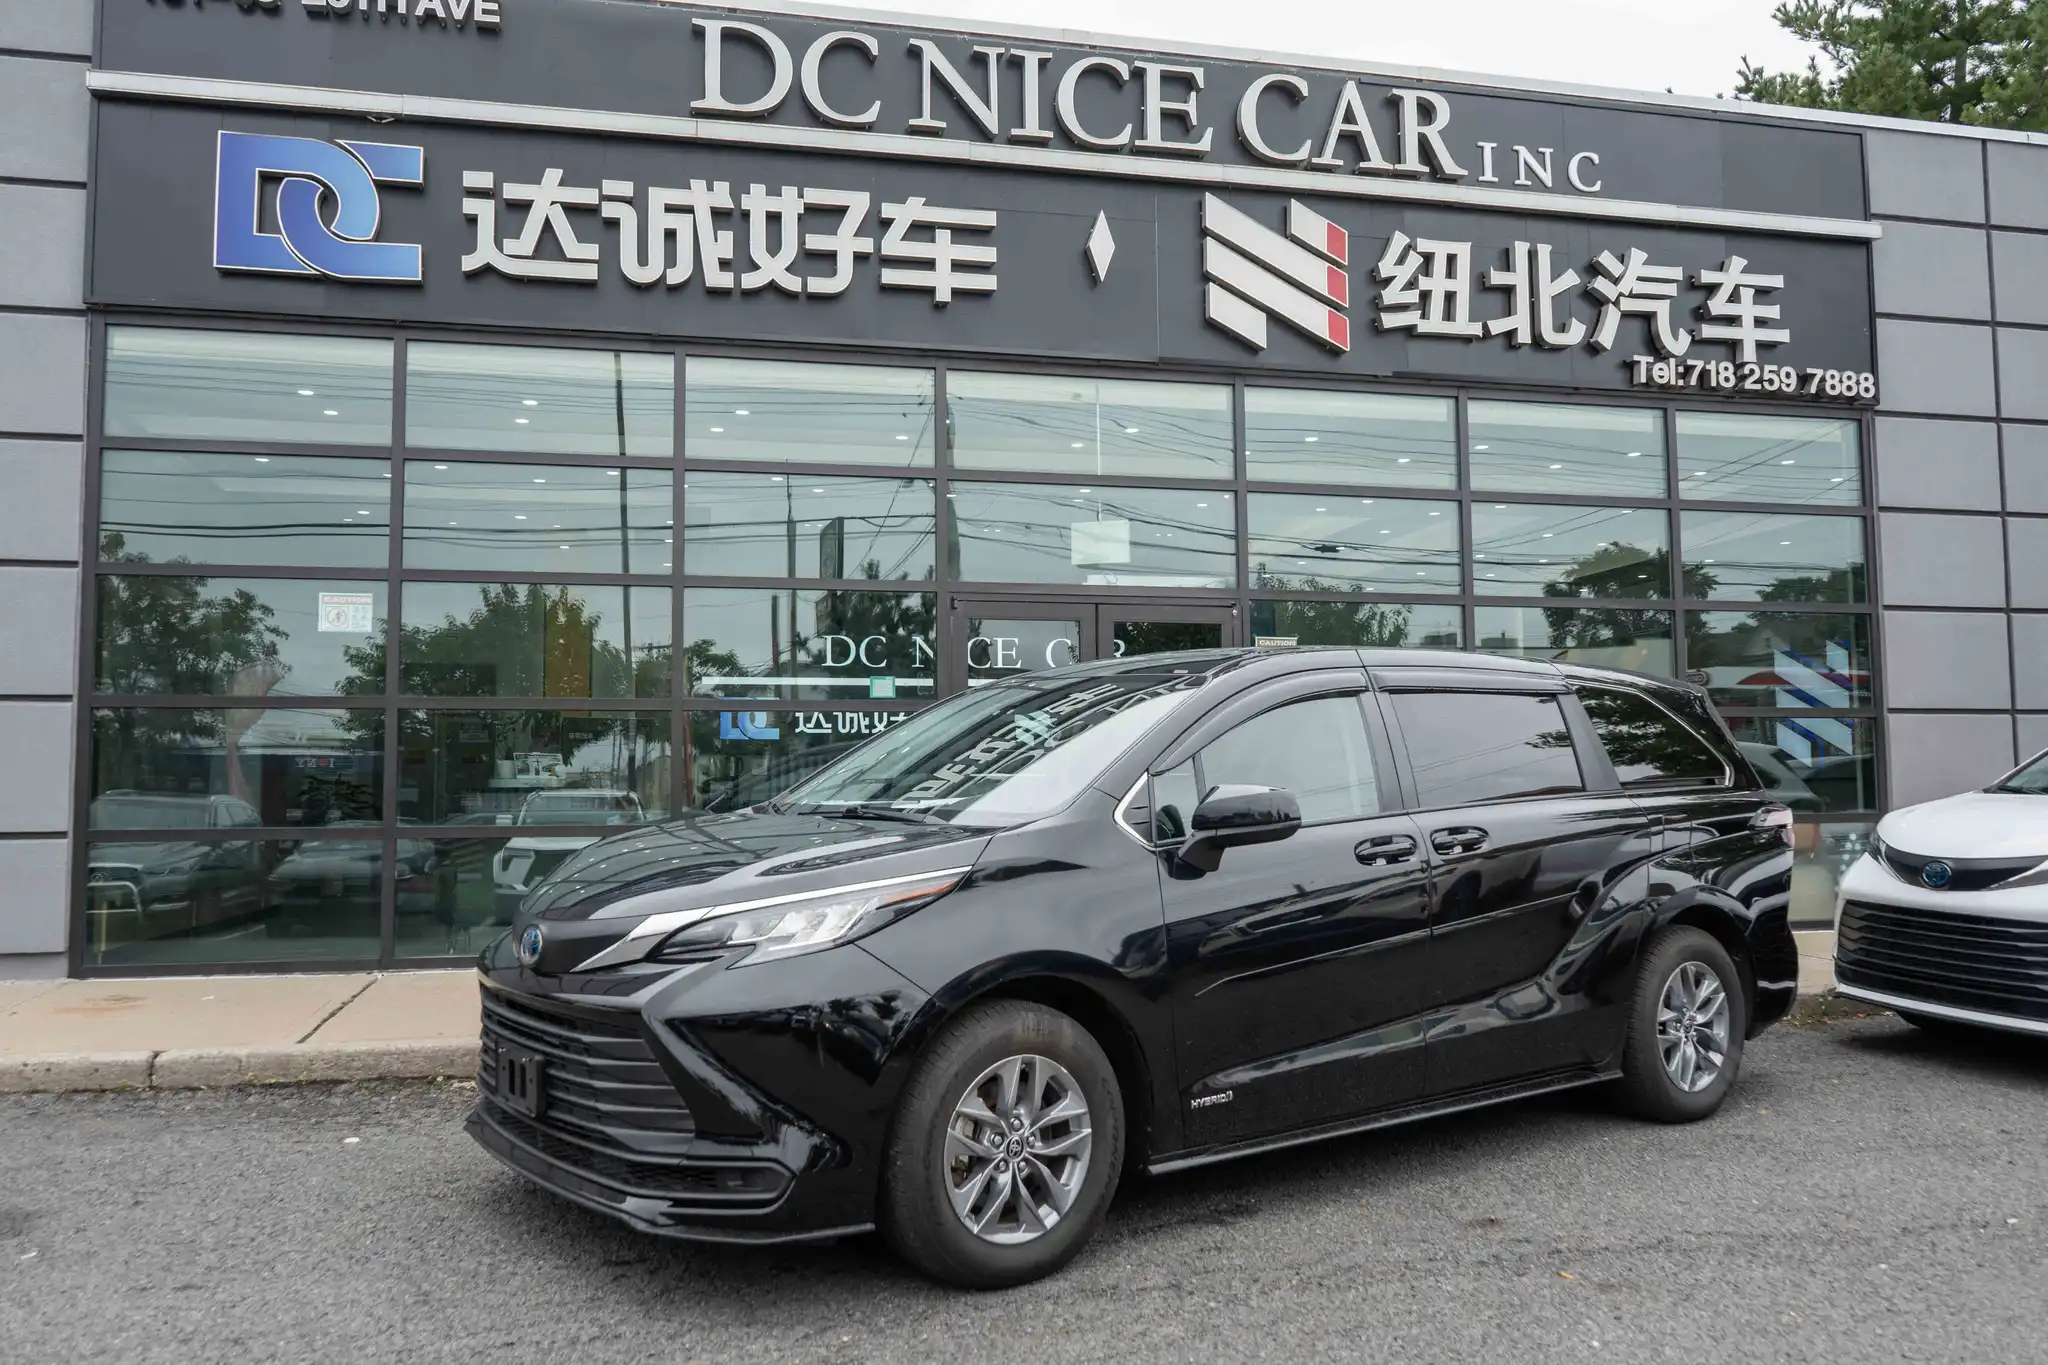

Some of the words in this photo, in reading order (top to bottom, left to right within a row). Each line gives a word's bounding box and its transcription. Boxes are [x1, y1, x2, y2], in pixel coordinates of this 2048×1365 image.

[414, 0, 500, 24] AVE
[690, 17, 882, 129] DC
[907, 38, 1214, 157] NICE
[1236, 74, 1469, 180] CAR
[1477, 141, 1602, 193] INC
[461, 167, 998, 307] 达诚好车
[1375, 230, 1791, 363] 纽北汽车
[1743, 363, 1798, 393] 259
[1805, 367, 1877, 399] 7888
[821, 634, 888, 669] DC
[911, 635, 1023, 670] NCE
[1259, 639, 1297, 647] CAUTION
[1191, 1094, 1228, 1109] HYBRID
